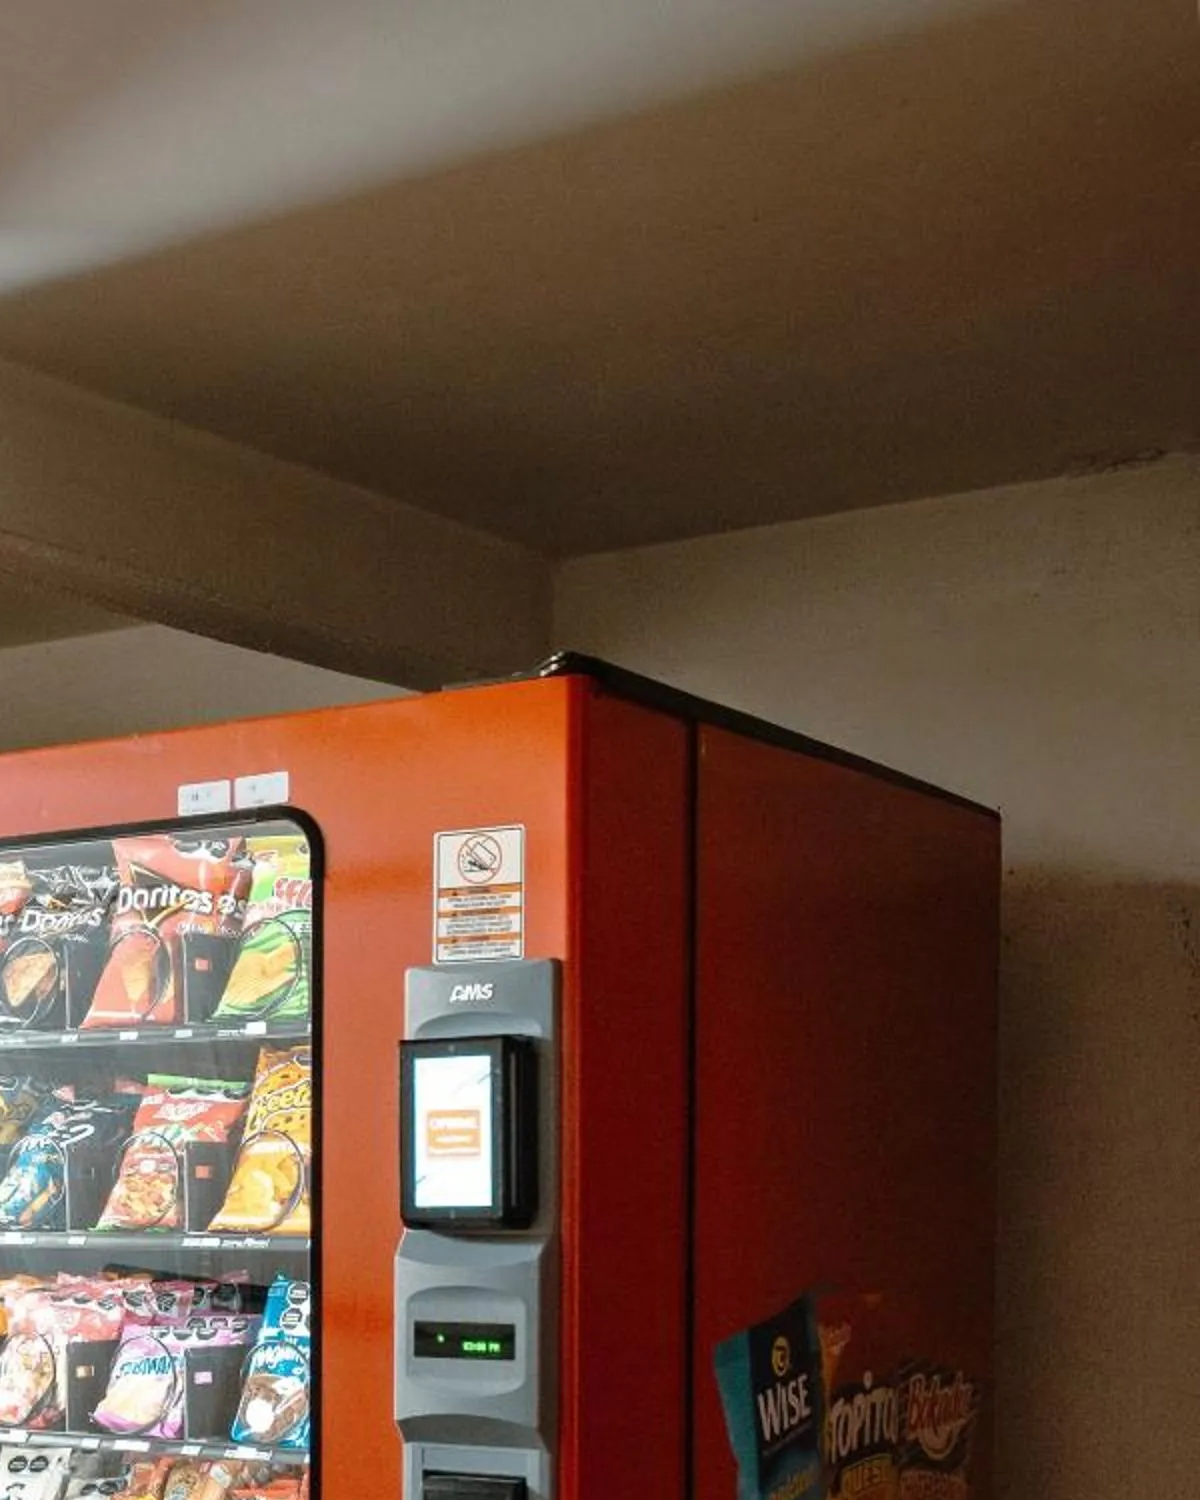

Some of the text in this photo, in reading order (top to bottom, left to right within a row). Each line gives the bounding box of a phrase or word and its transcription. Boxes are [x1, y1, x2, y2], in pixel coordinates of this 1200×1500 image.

[118, 884, 213, 914] Doritos
[757, 1372, 812, 1442] WISE
[831, 1370, 898, 1464] TOPITO
